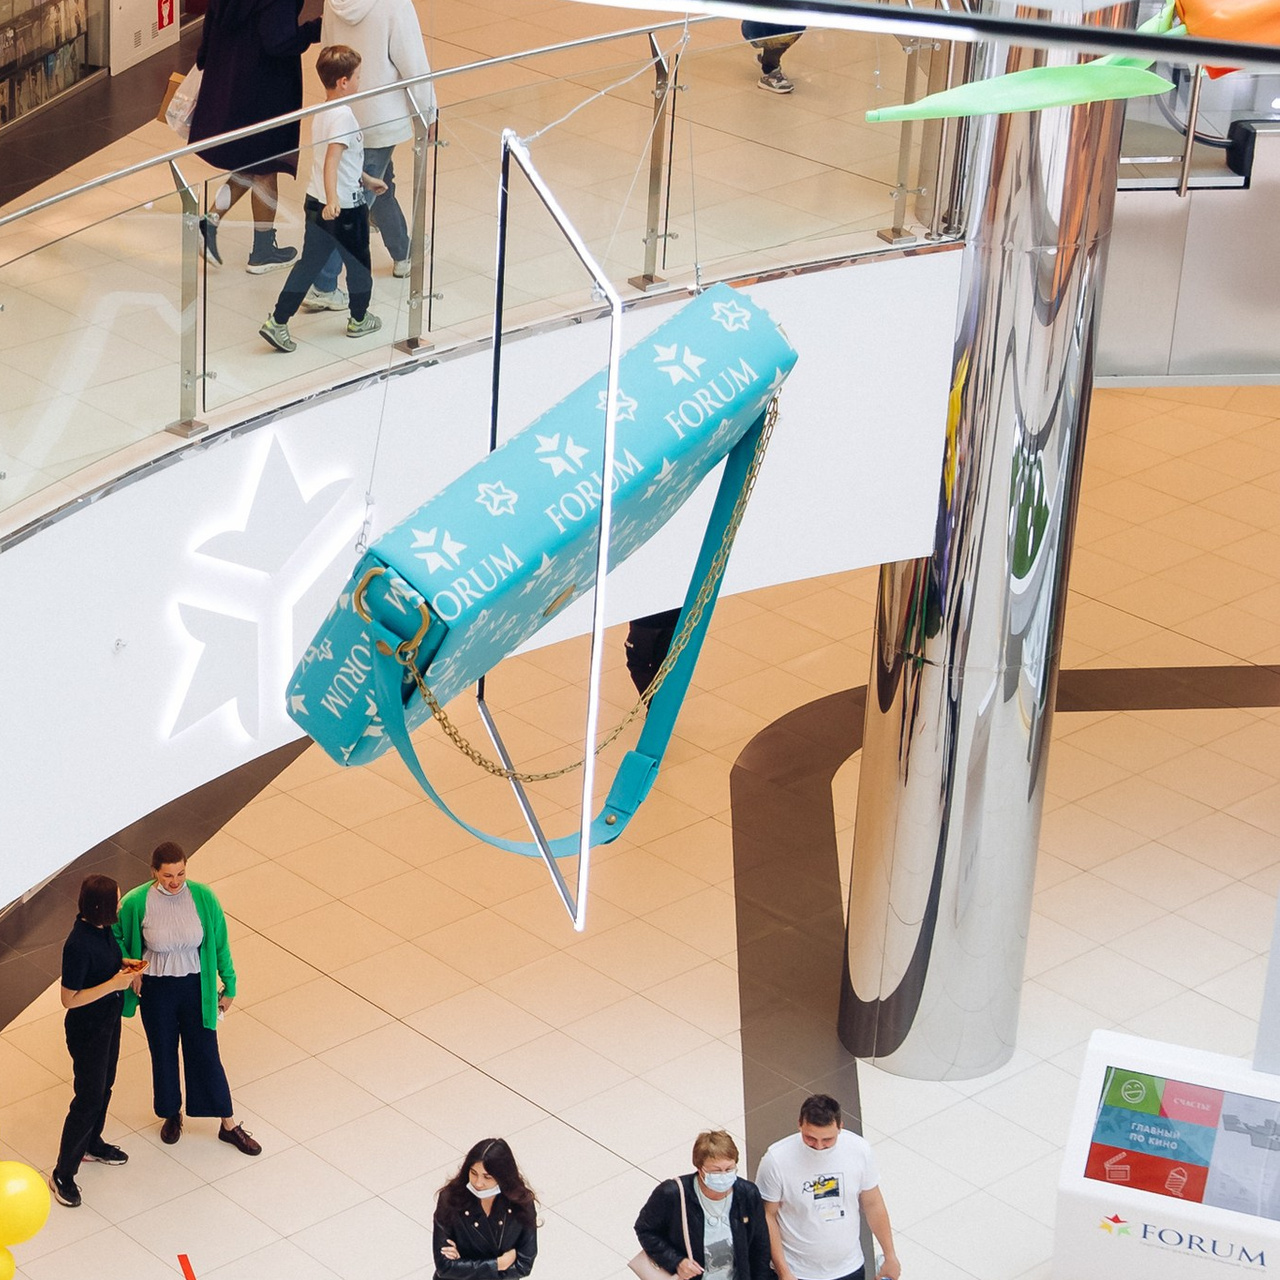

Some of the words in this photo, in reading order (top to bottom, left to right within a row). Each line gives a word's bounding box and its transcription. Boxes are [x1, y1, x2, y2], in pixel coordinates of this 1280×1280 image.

[663, 357, 760, 440] FORUM
[432, 543, 524, 621] ORUM
[1129, 1132, 1146, 1143] ПО
[1147, 1136, 1179, 1150] КИНО
[1131, 1122, 1181, 1140] ГЛАВНЫЙ
[1141, 1222, 1267, 1267] FORUM
